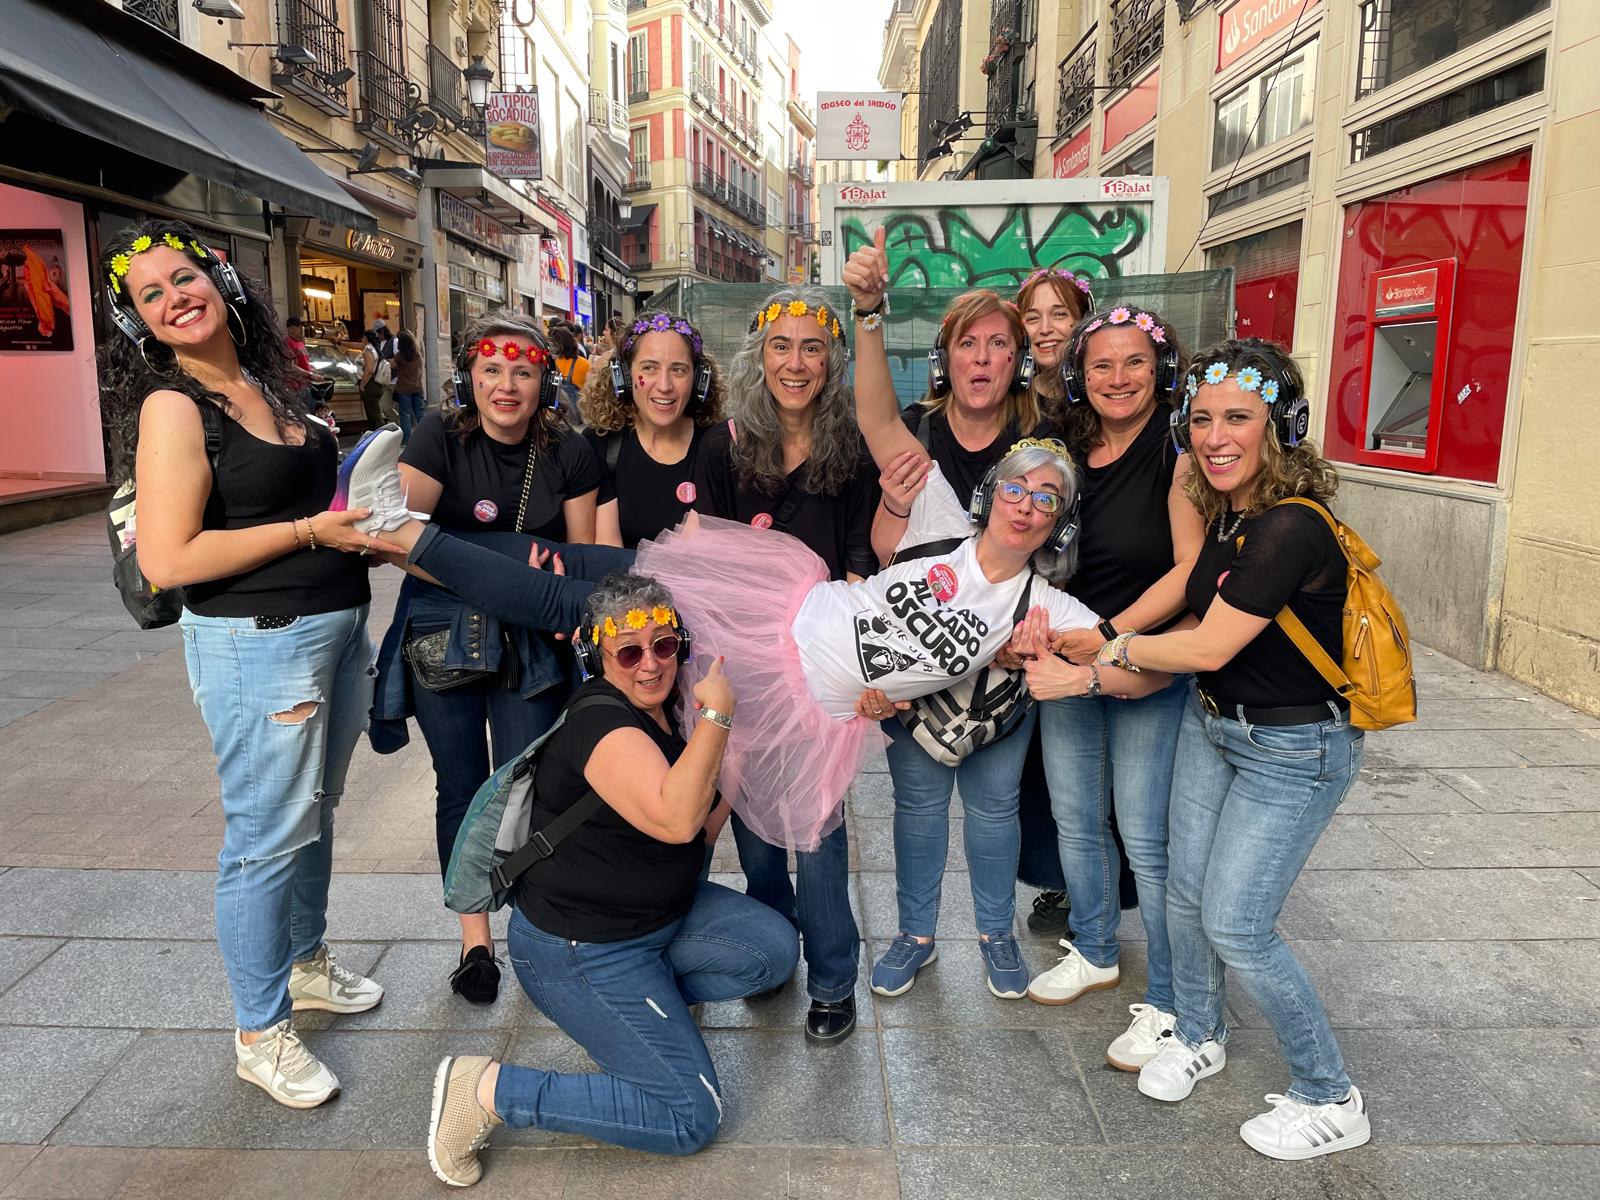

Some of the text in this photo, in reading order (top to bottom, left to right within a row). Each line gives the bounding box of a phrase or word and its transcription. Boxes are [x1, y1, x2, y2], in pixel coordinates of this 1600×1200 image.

[503, 95, 537, 112] TIPICO
[487, 108, 537, 125] BOCADILLO
[488, 152, 539, 160] ESPECIALIDAD
[489, 159, 537, 167] EN RACIONES
[1393, 284, 1427, 299] Santander
[909, 578, 933, 607] AL
[932, 609, 981, 658] LADO
[949, 608, 989, 638] ASO
[885, 582, 970, 677] OSCURO
